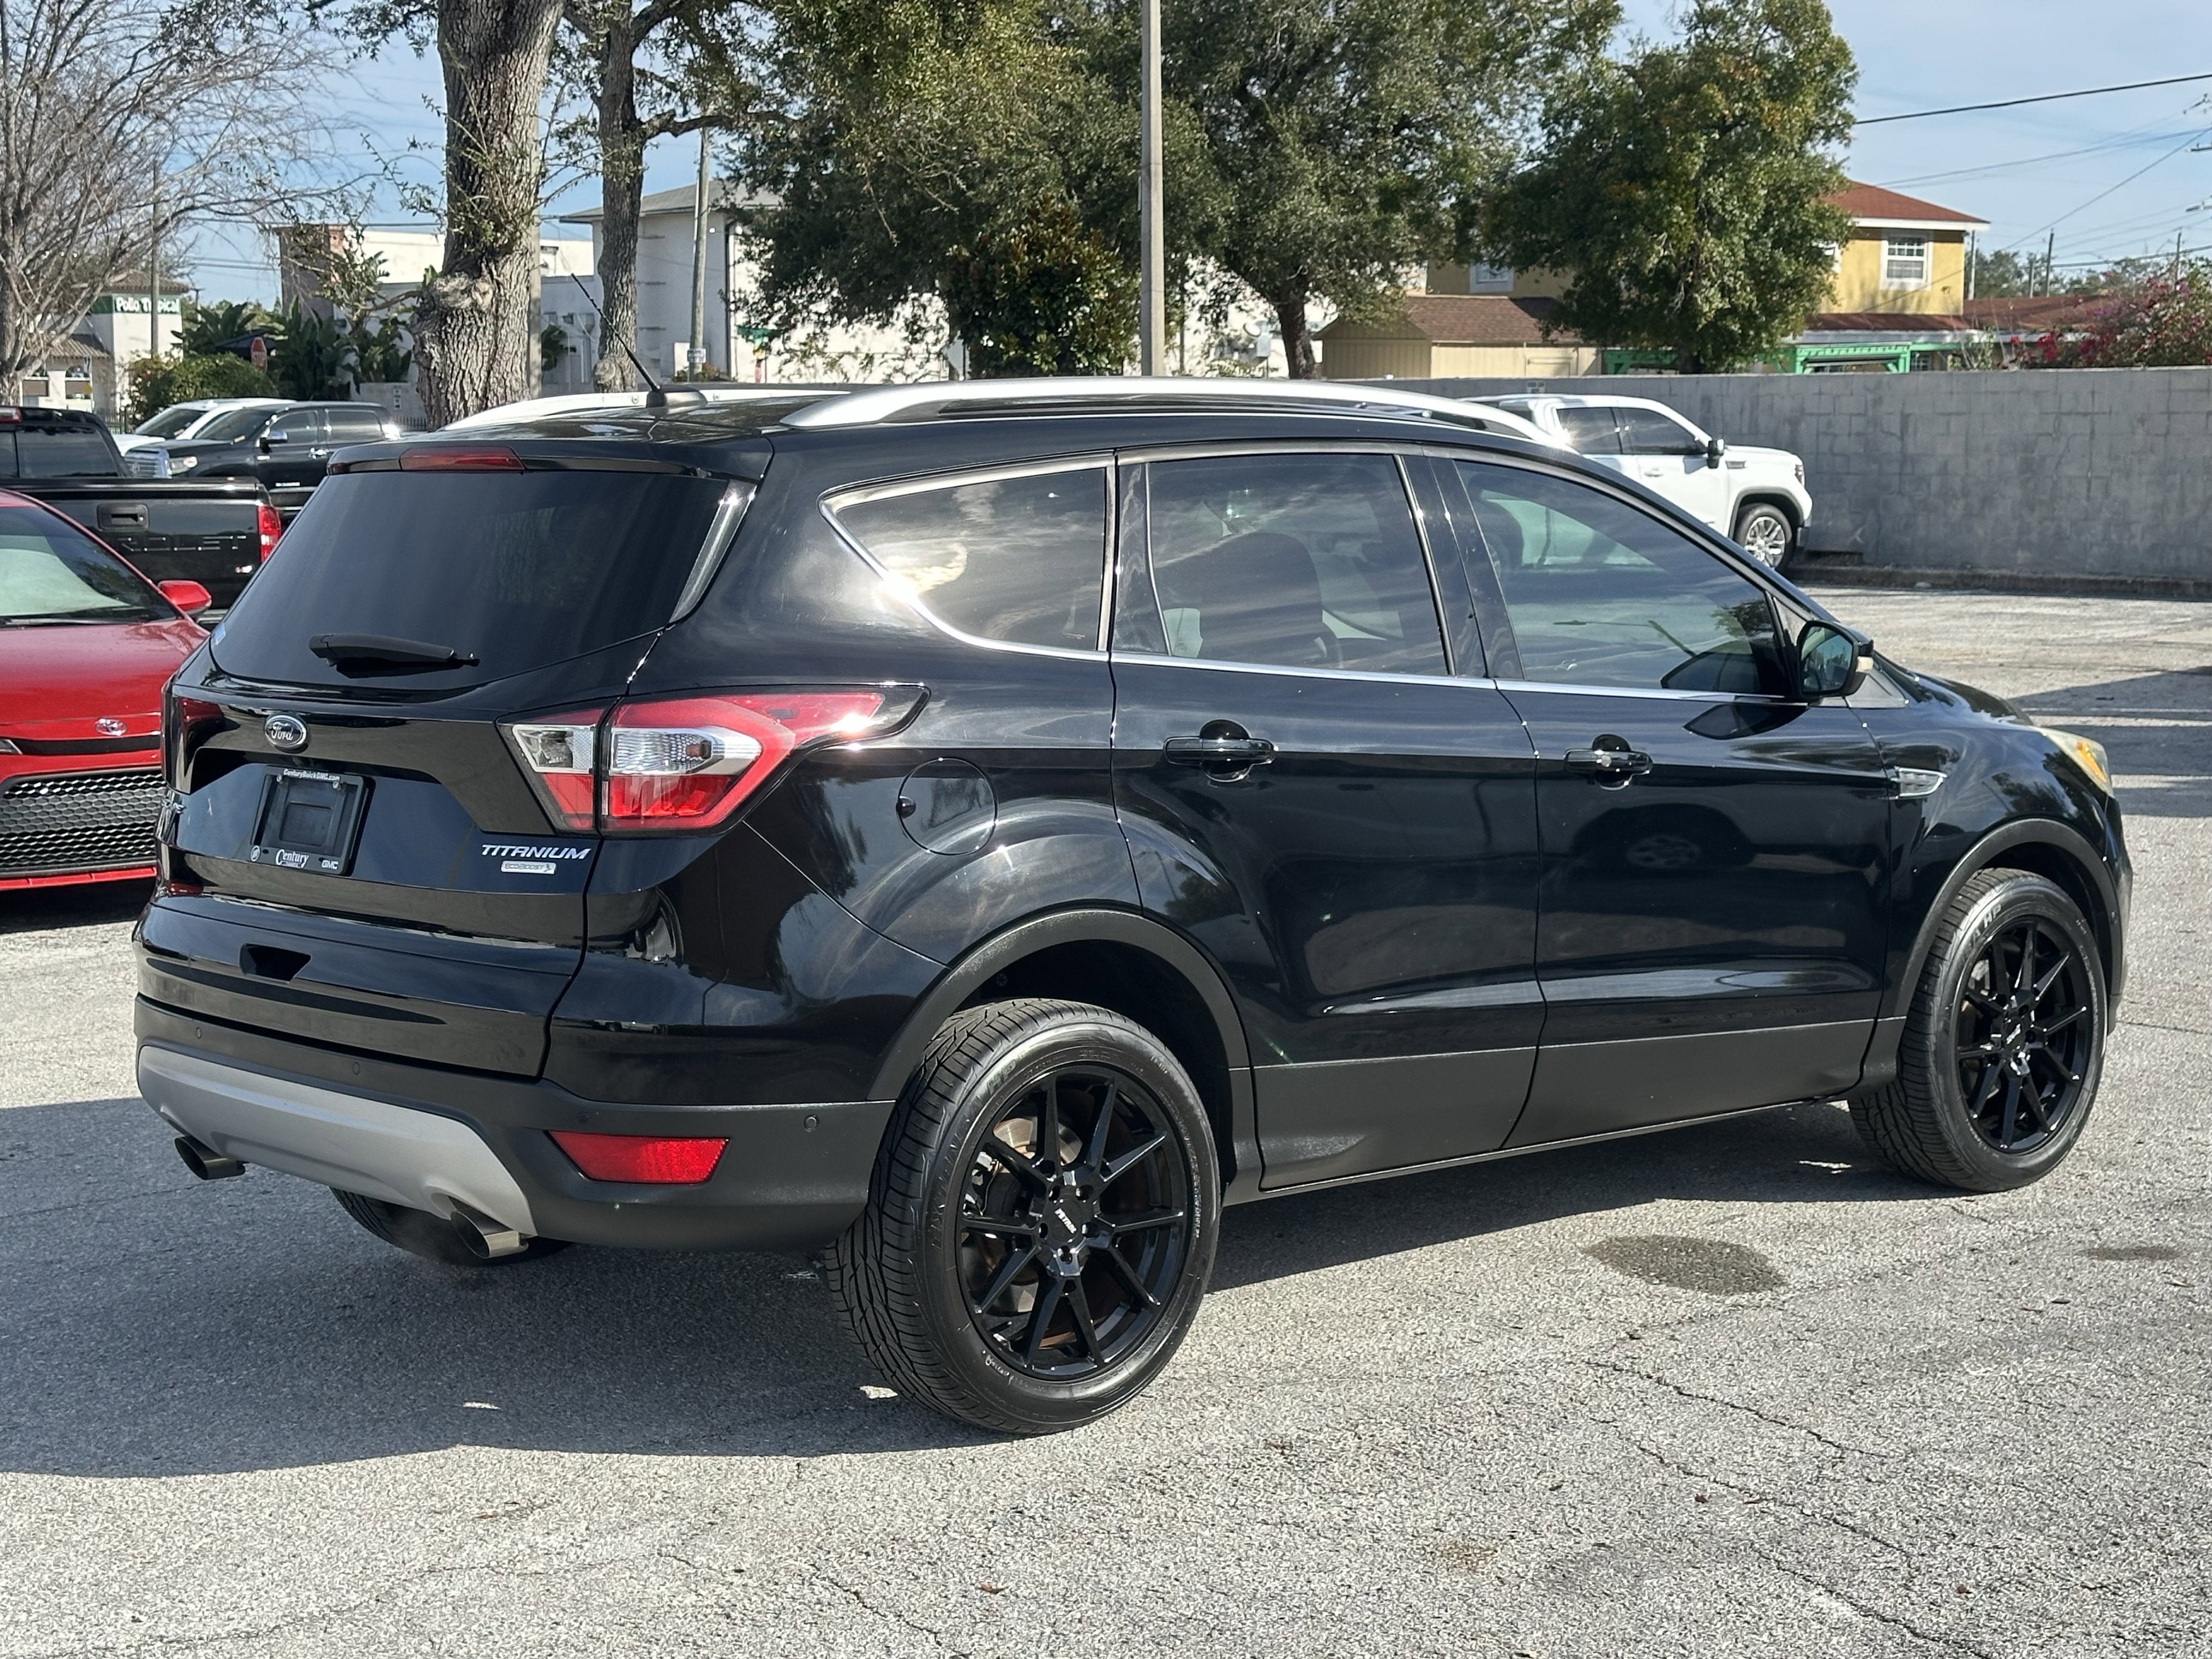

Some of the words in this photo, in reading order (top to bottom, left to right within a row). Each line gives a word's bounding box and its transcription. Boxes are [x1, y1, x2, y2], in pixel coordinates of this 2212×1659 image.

[115, 297, 140, 312] Pollo
[271, 721, 294, 741] Ford
[275, 849, 309, 868] Century
[482, 844, 591, 859] TITANIUM
[321, 860, 339, 870] GMC
